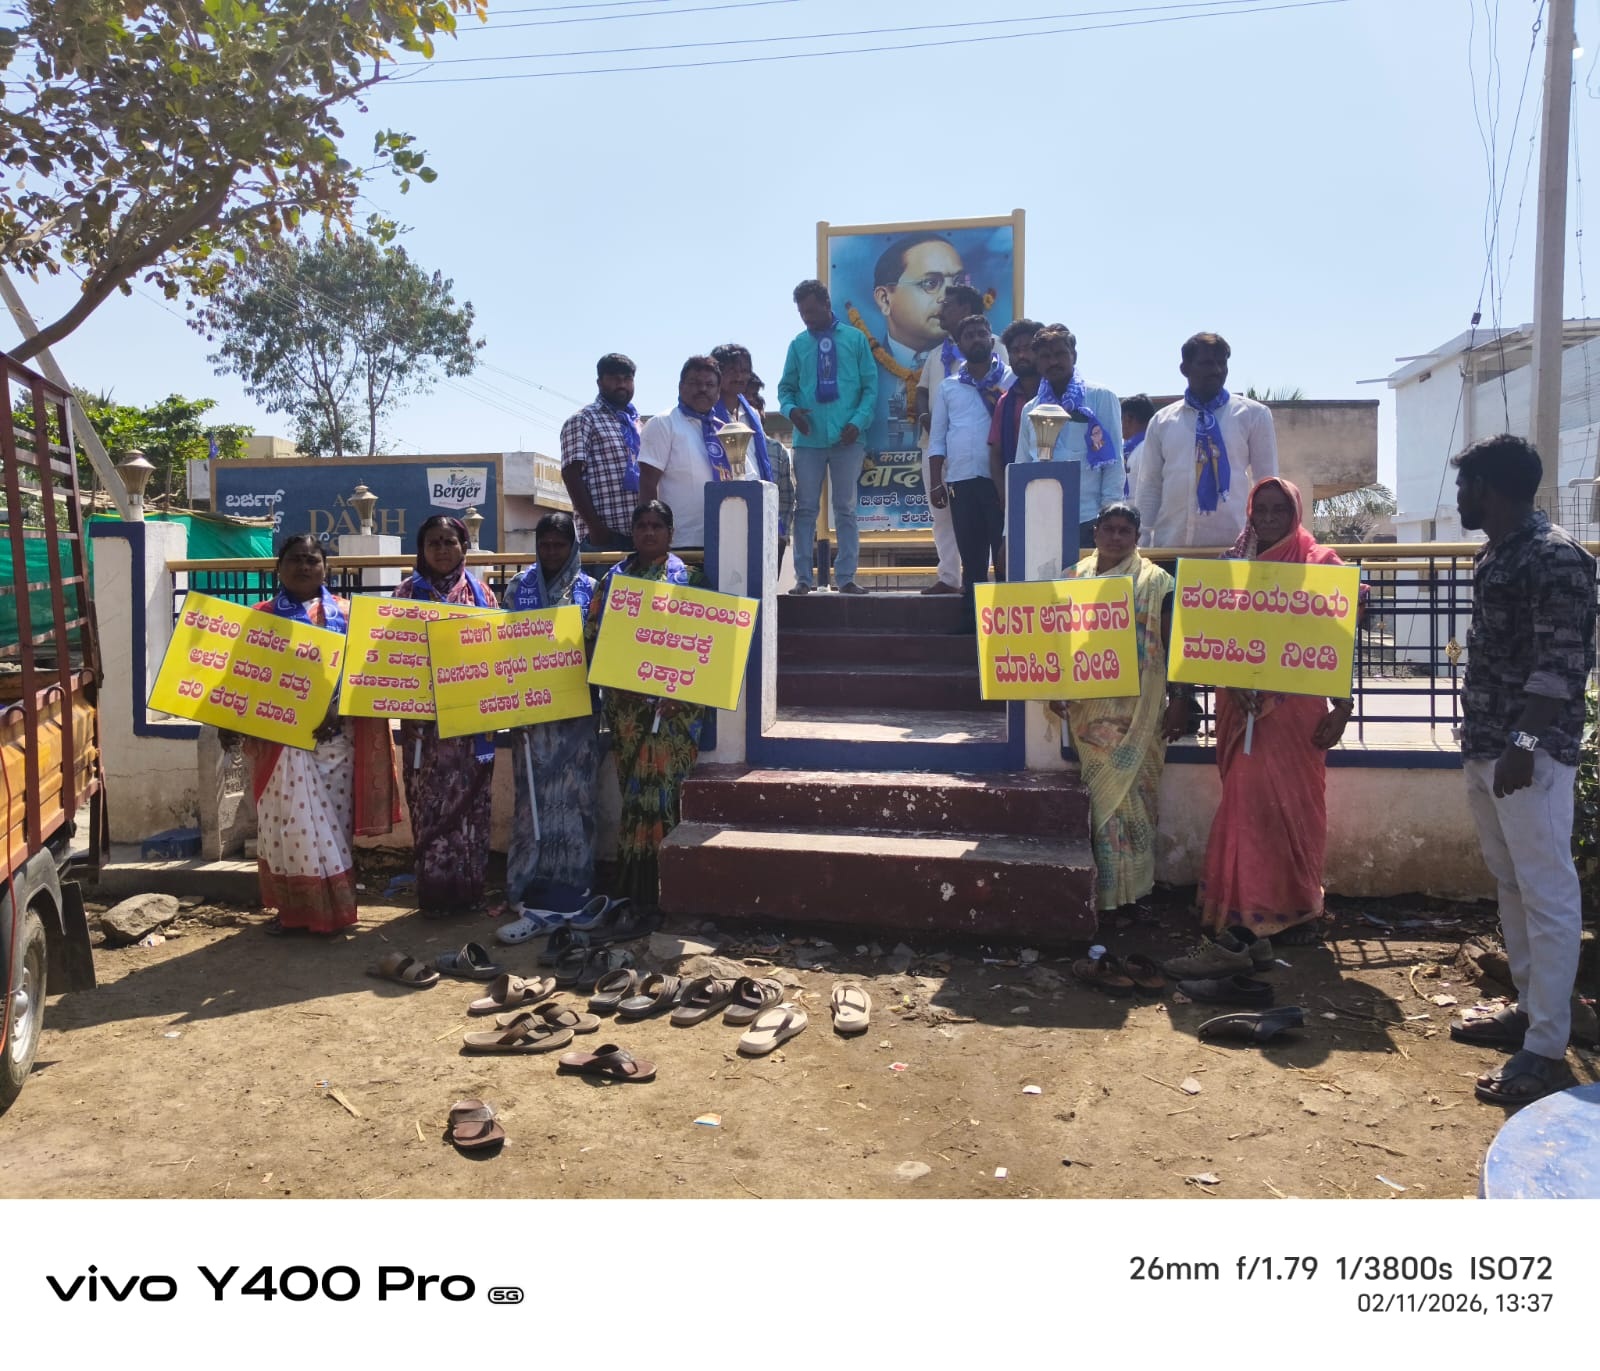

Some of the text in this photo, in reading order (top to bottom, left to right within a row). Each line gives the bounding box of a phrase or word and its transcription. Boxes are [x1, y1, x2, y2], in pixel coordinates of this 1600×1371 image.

[433, 484, 481, 502] Berger
[610, 588, 751, 627] ಭ್ರಷ್ಟ ಪಂಚಾಯಿತಿ
[981, 591, 1130, 635] SC/ST ಅನುದಾನ
[1181, 581, 1350, 618] ಪಂಚಾಯತಿಯ
[184, 609, 341, 667] ಕಲಕೇರಿ ಸರ್ವೇ ನಂ. 1
[460, 617, 554, 645] ಮಳಿಗೆ ಹಂಚಿಕೆಯಲ್ಲಿ
[635, 627, 713, 664] ಆಡಳಿತಕ್ಕೆ
[189, 647, 229, 669] ಅಳತೆ
[233, 661, 272, 682] ಮಾಡಿ
[366, 650, 379, 662] 5
[437, 649, 582, 684] ಮೀಸಲಾತಿ ಅನ್ವಯ ದಲಿತರಿಗೂ
[995, 648, 1120, 683] ಮಾಹಿತಿ ನೀಡಿ
[1183, 632, 1338, 671] ಮಾಹಿತಿ ನೀಡಿ
[349, 673, 420, 689] ಹಣಕಾಸು
[637, 661, 695, 692] ಧಿಕ್ಕಾರ
[178, 680, 298, 725] ವರಿ ತೆರವು ಮಾಡಿ.
[372, 698, 436, 713] ತನಿಖೆಯ
[479, 688, 552, 714] ಅವಕಾಶ ಕೊಡಿ
